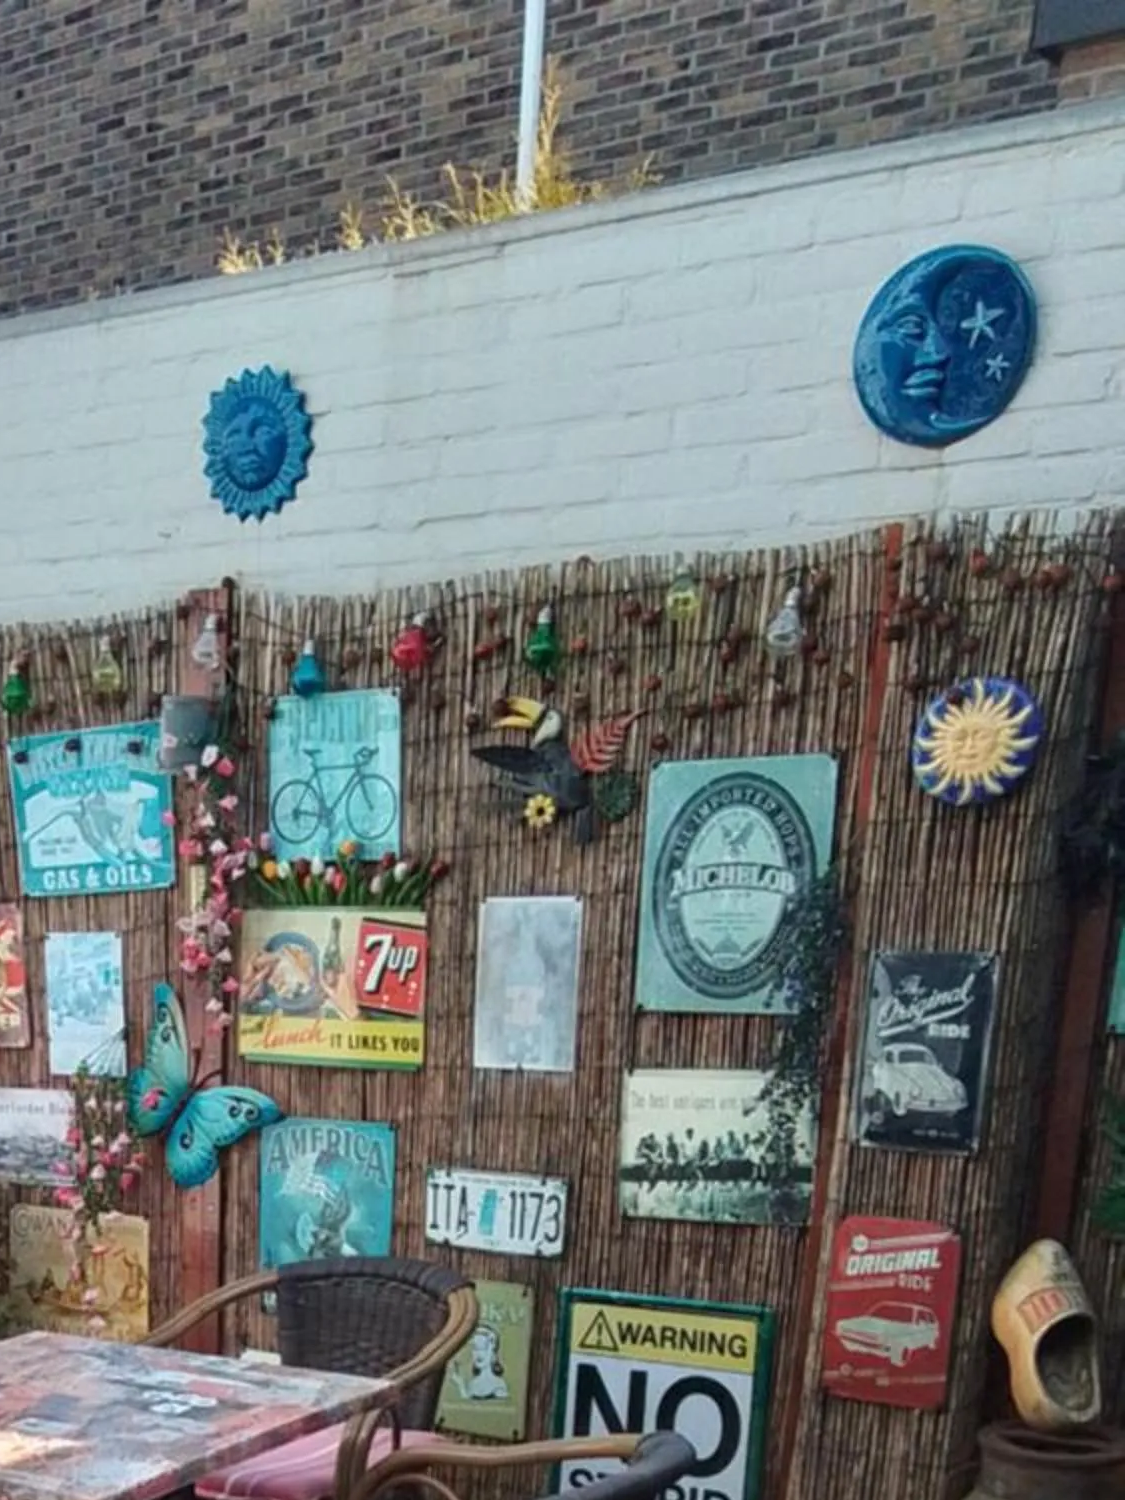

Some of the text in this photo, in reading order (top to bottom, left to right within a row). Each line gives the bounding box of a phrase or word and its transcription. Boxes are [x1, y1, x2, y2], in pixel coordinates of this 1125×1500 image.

[43, 863, 152, 890] GAS & OILS
[670, 864, 796, 896] MICHELOB
[330, 1034, 342, 1050] IT
[348, 1034, 387, 1051] LIKES
[392, 1036, 420, 1053] YOU
[265, 1126, 390, 1189] AMERICA
[509, 1190, 562, 1243] 1173
[846, 1248, 942, 1276] ORIGINAL
[898, 1274, 933, 1291] RIDE
[617, 1322, 747, 1359] WARNING
[573, 1363, 741, 1477] NO
